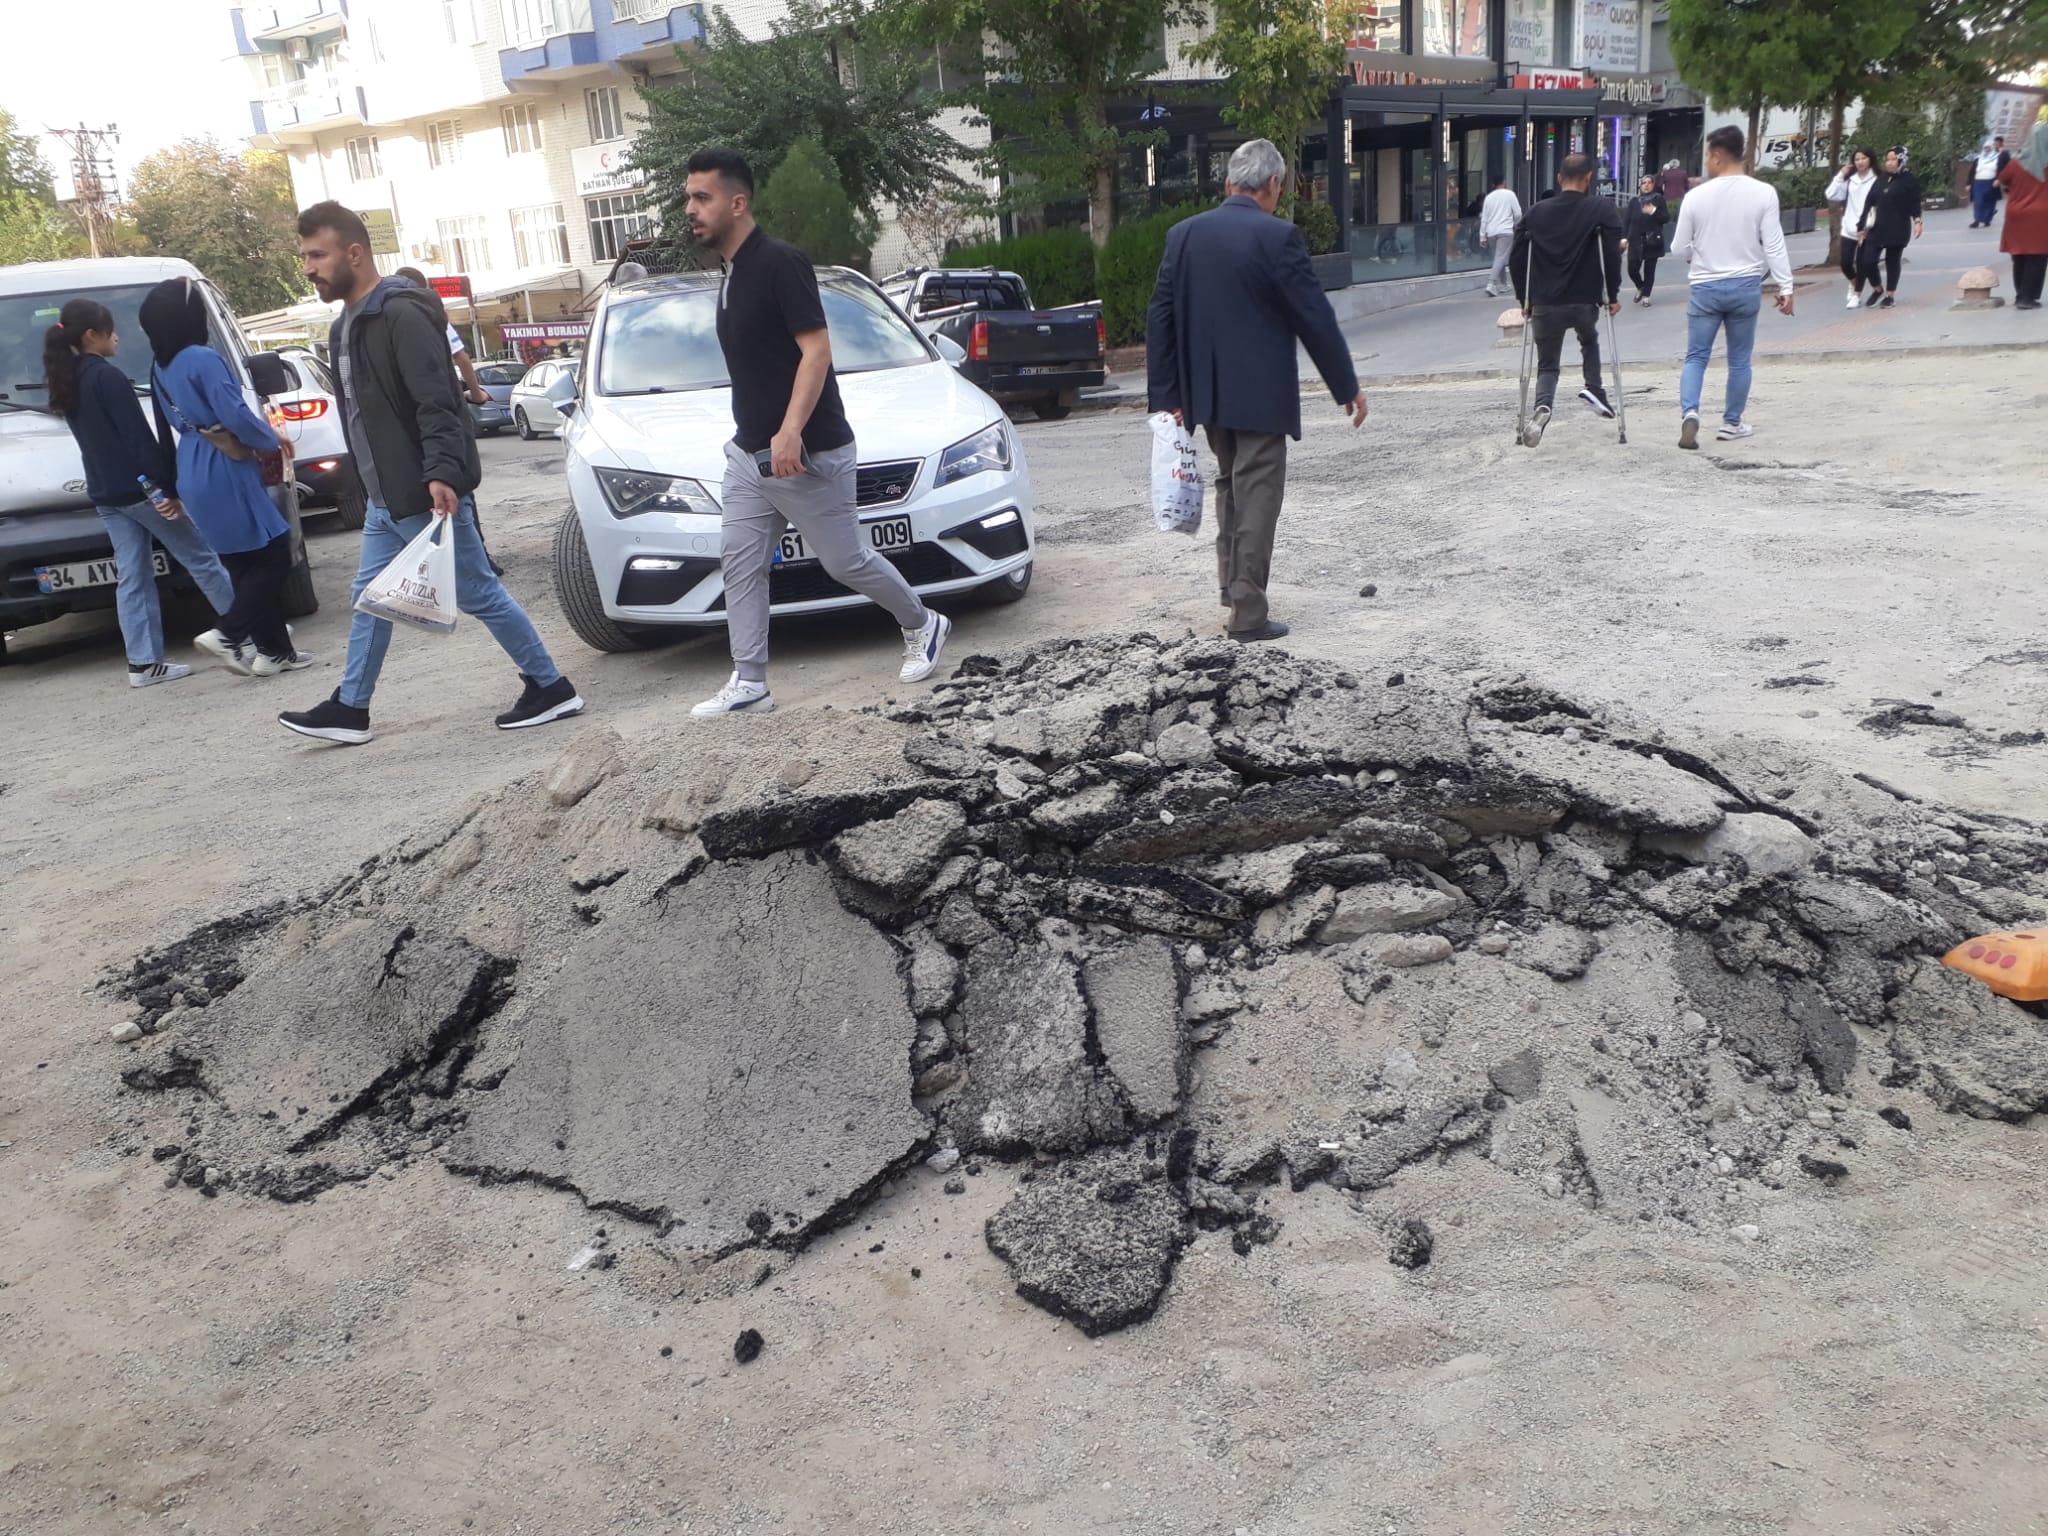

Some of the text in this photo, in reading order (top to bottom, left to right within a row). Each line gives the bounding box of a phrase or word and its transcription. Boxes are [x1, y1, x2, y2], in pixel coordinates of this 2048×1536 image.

[1601, 77, 1653, 106] Emre Optik
[582, 178, 611, 190] BATMAN
[503, 327, 545, 338] YAKINDA
[871, 521, 907, 548] 009
[781, 534, 804, 559] 61
[50, 568, 75, 588] 34
